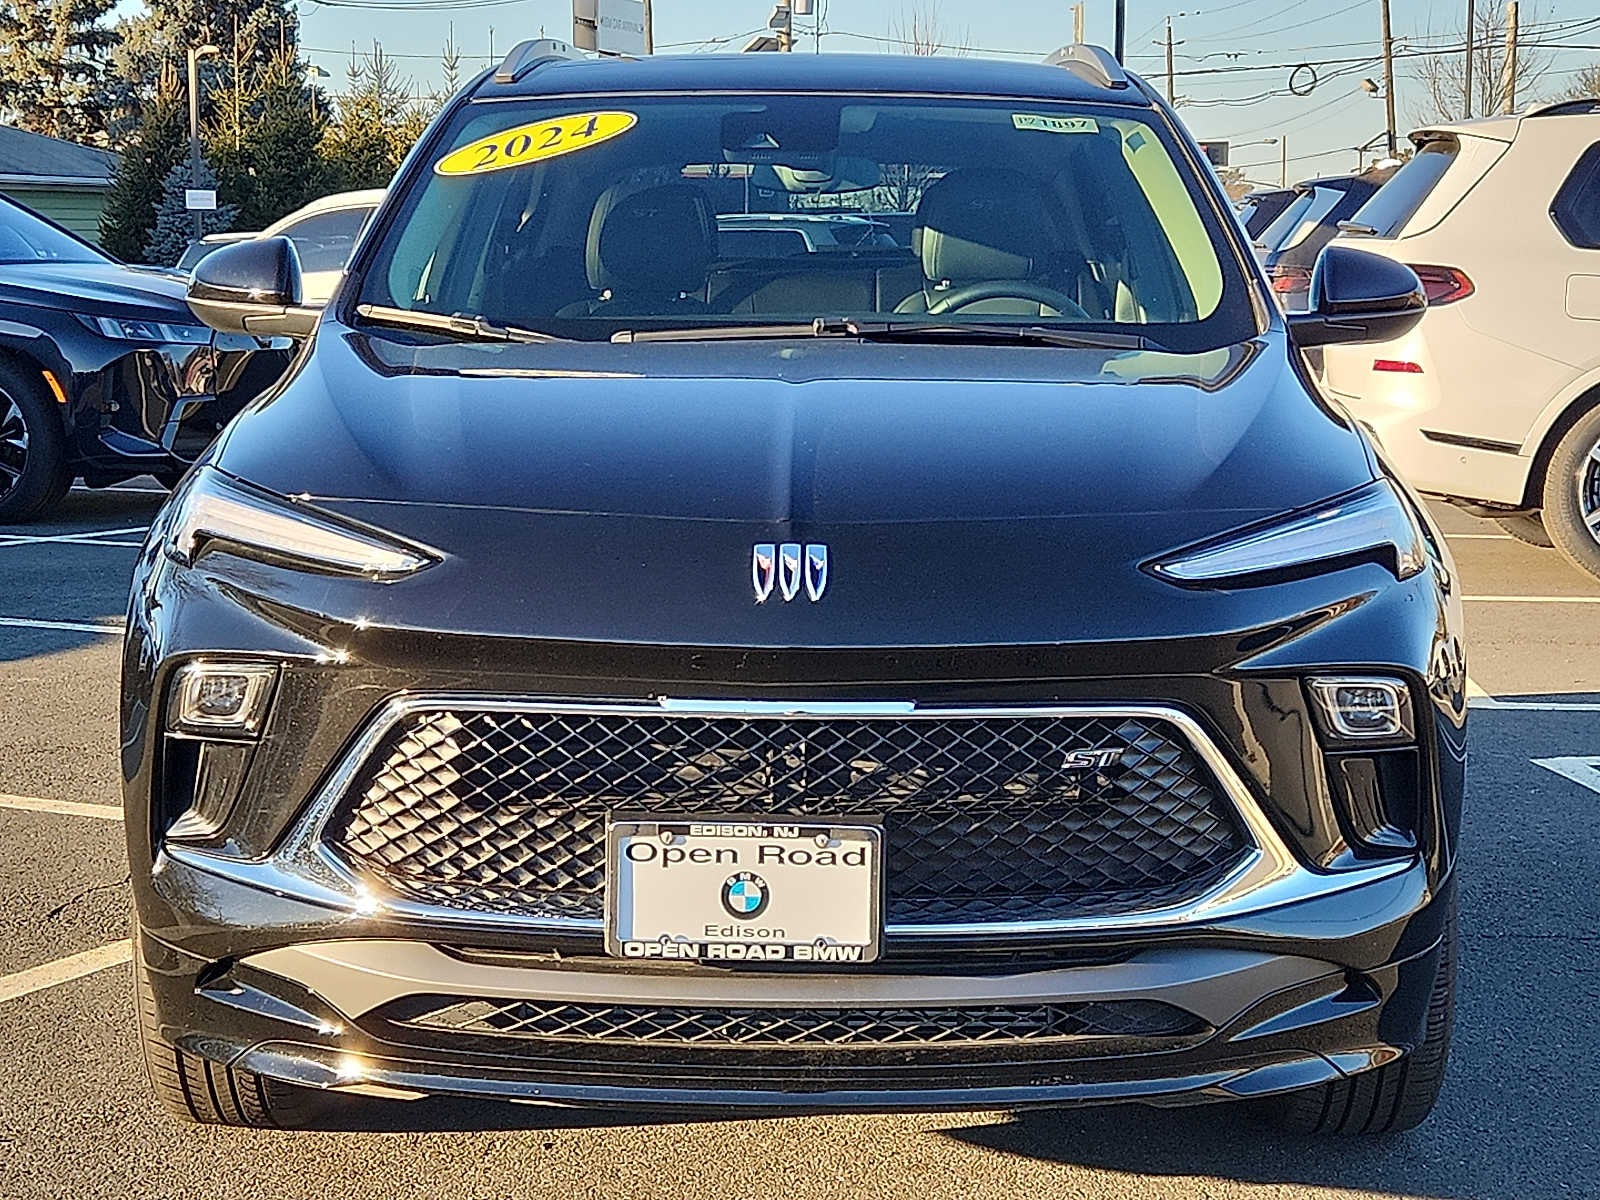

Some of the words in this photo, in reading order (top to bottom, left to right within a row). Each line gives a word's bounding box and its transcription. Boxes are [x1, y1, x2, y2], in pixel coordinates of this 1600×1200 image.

[473, 115, 599, 168] 2024
[1061, 748, 1124, 769] ST
[773, 826, 799, 838] NJ
[625, 842, 738, 868] Open
[758, 845, 866, 867] Road
[726, 872, 766, 888] BMW
[704, 924, 785, 939] Edison
[624, 941, 699, 958] OPEN
[707, 943, 788, 960] ROAD
[793, 944, 861, 961] BMW
